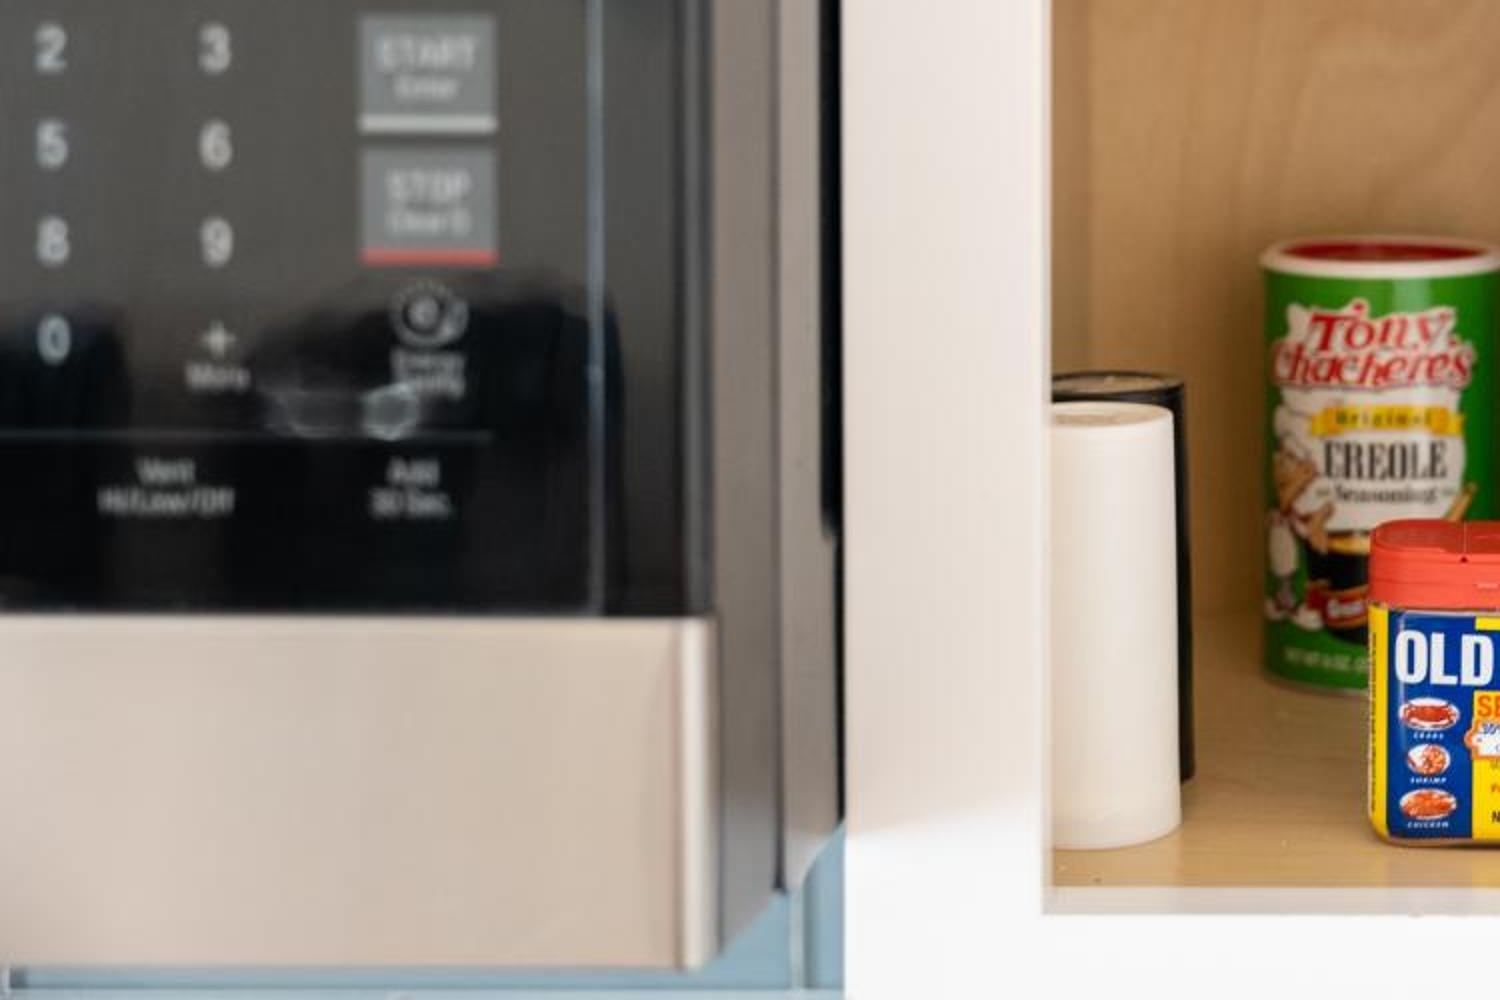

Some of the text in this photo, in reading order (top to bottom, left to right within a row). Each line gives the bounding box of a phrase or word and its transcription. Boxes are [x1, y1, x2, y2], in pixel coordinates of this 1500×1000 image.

[35, 23, 67, 74] 2
[200, 23, 232, 74] 3
[376, 34, 477, 70] START
[36, 120, 68, 168] 5
[200, 120, 232, 169] 6
[386, 168, 472, 201] STOP
[36, 216, 69, 266] 8
[201, 216, 232, 266] 9
[38, 315, 70, 364] 0
[1324, 440, 1447, 481] CREOLE
[1395, 630, 1494, 687] OLD
